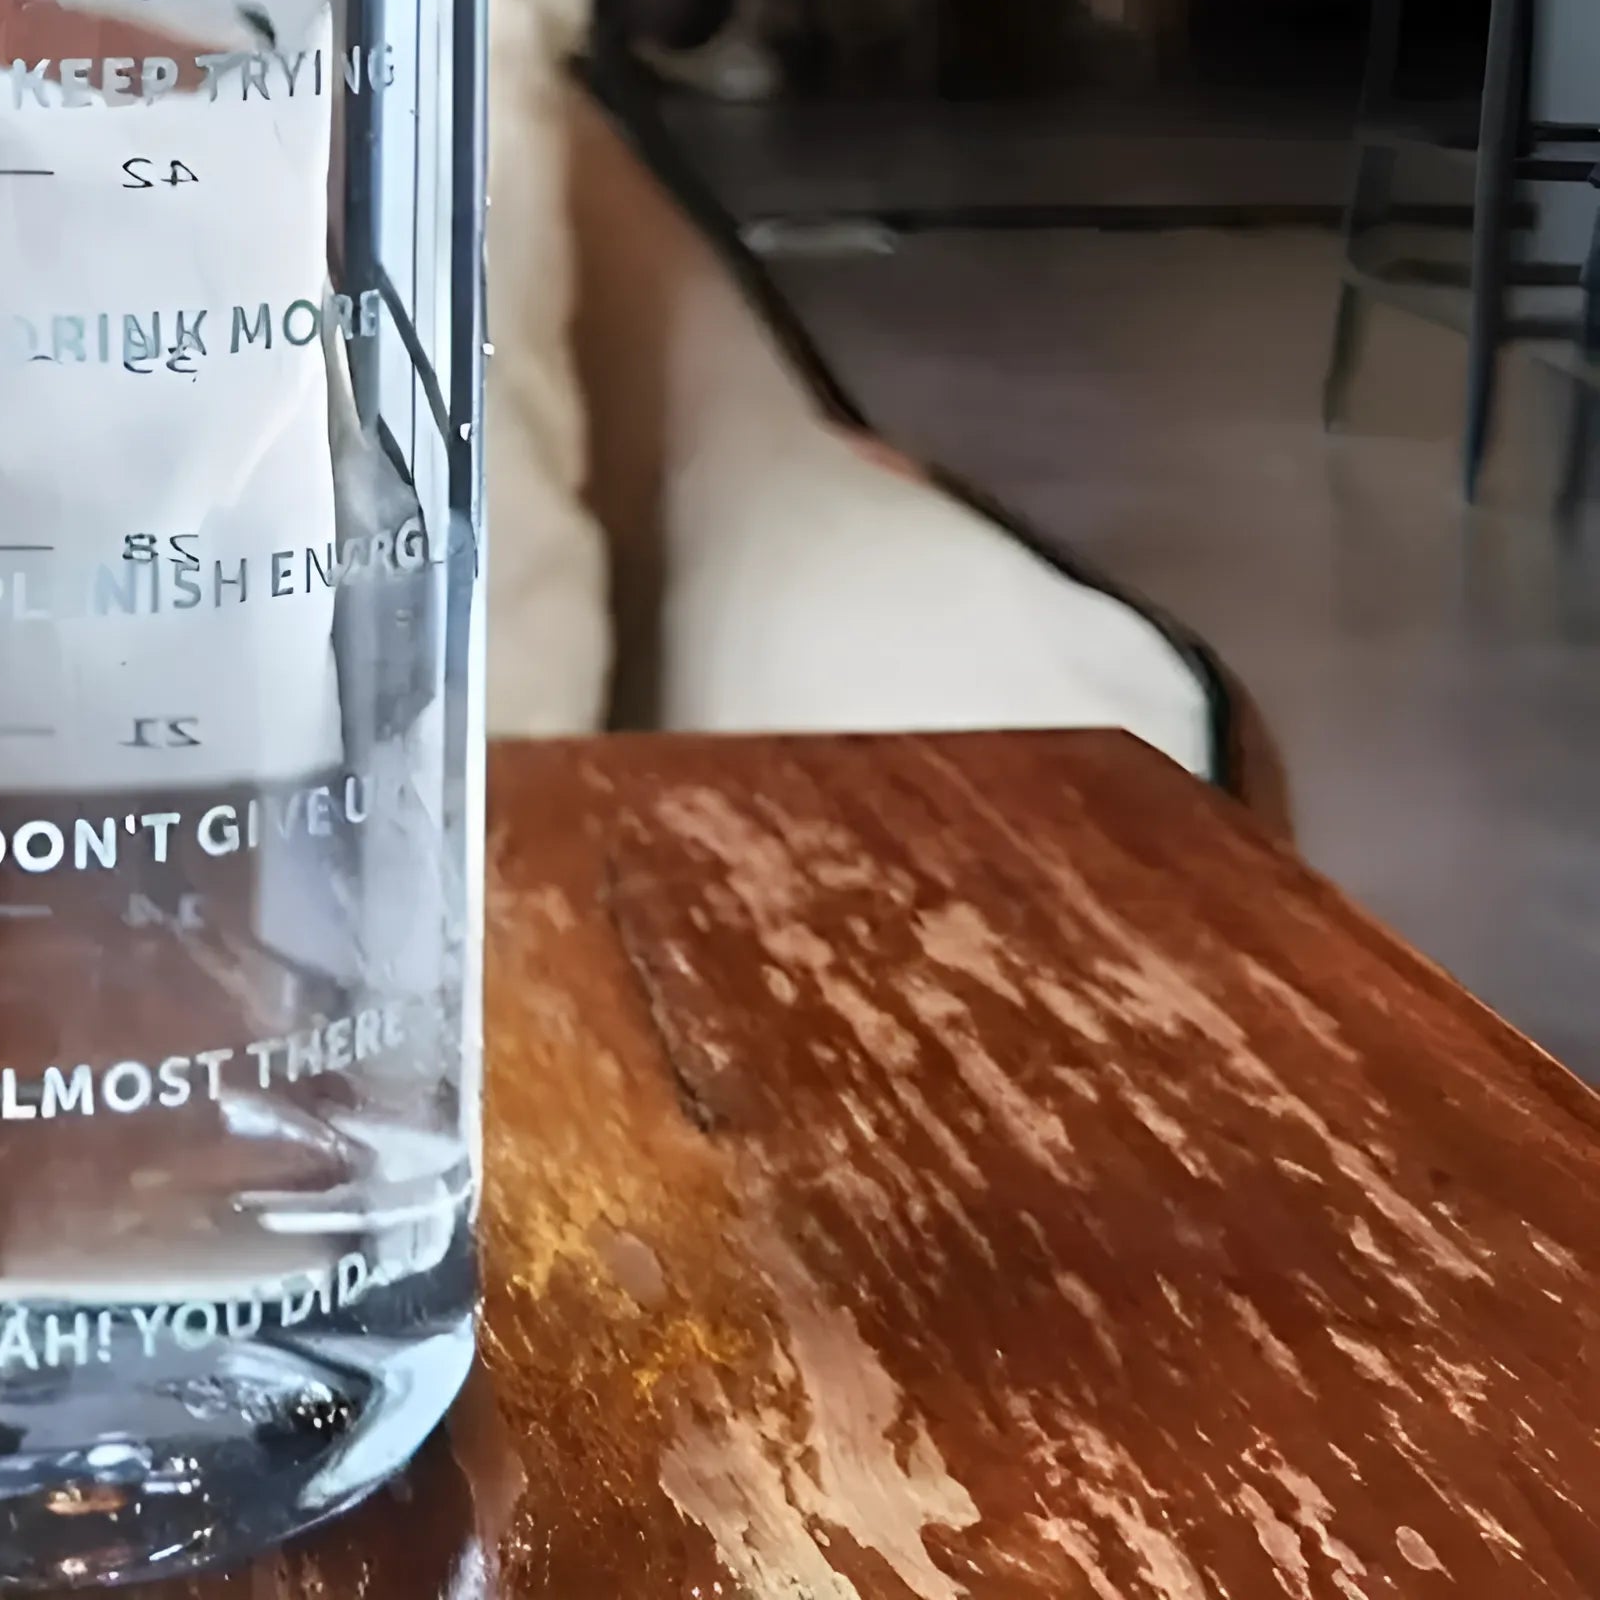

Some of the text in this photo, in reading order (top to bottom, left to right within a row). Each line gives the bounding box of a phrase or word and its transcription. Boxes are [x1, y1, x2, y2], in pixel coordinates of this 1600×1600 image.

[194, 42, 396, 103] TRYING
[197, 786, 333, 858] GIVE
[131, 1296, 264, 1358] YOU
